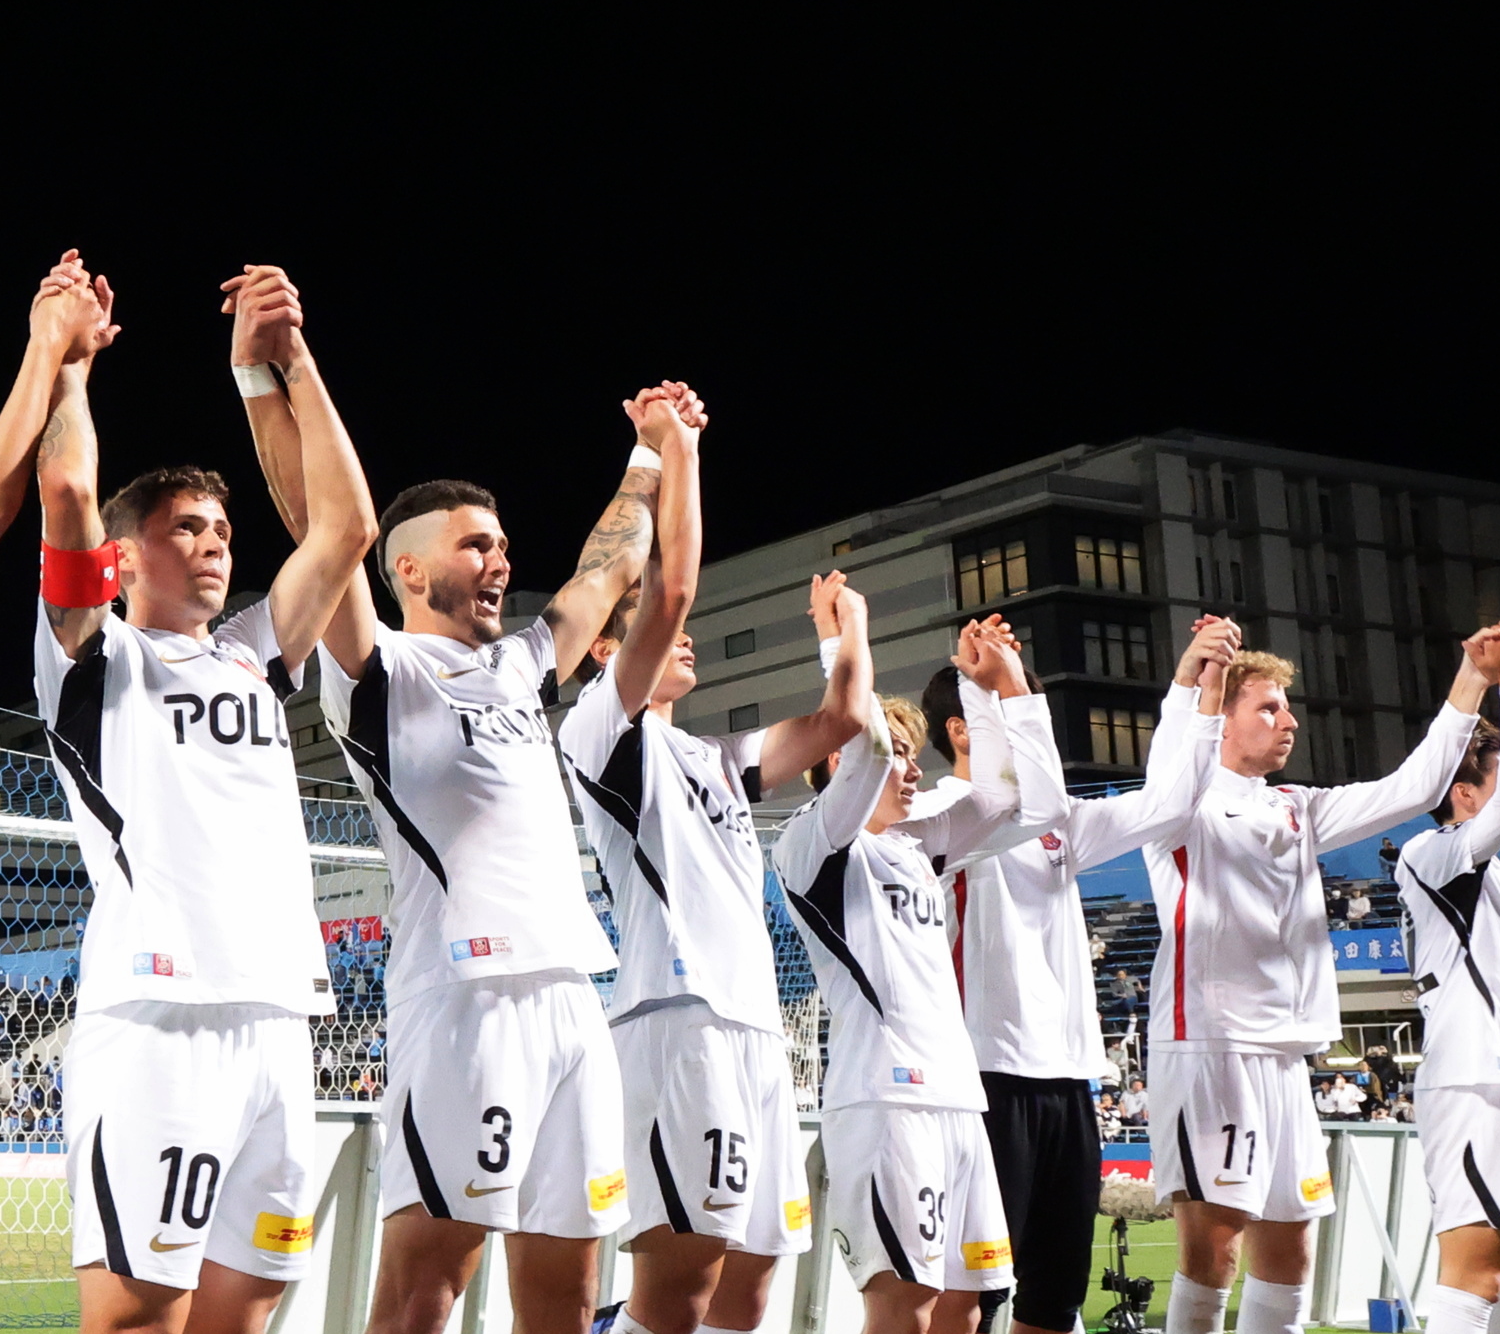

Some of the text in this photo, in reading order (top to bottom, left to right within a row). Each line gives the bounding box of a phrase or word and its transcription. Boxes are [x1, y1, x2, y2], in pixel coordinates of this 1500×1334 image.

[477, 1105, 512, 1174] 3
[704, 1128, 748, 1193] 15
[1221, 1123, 1256, 1176] 11
[159, 1146, 221, 1230] 10
